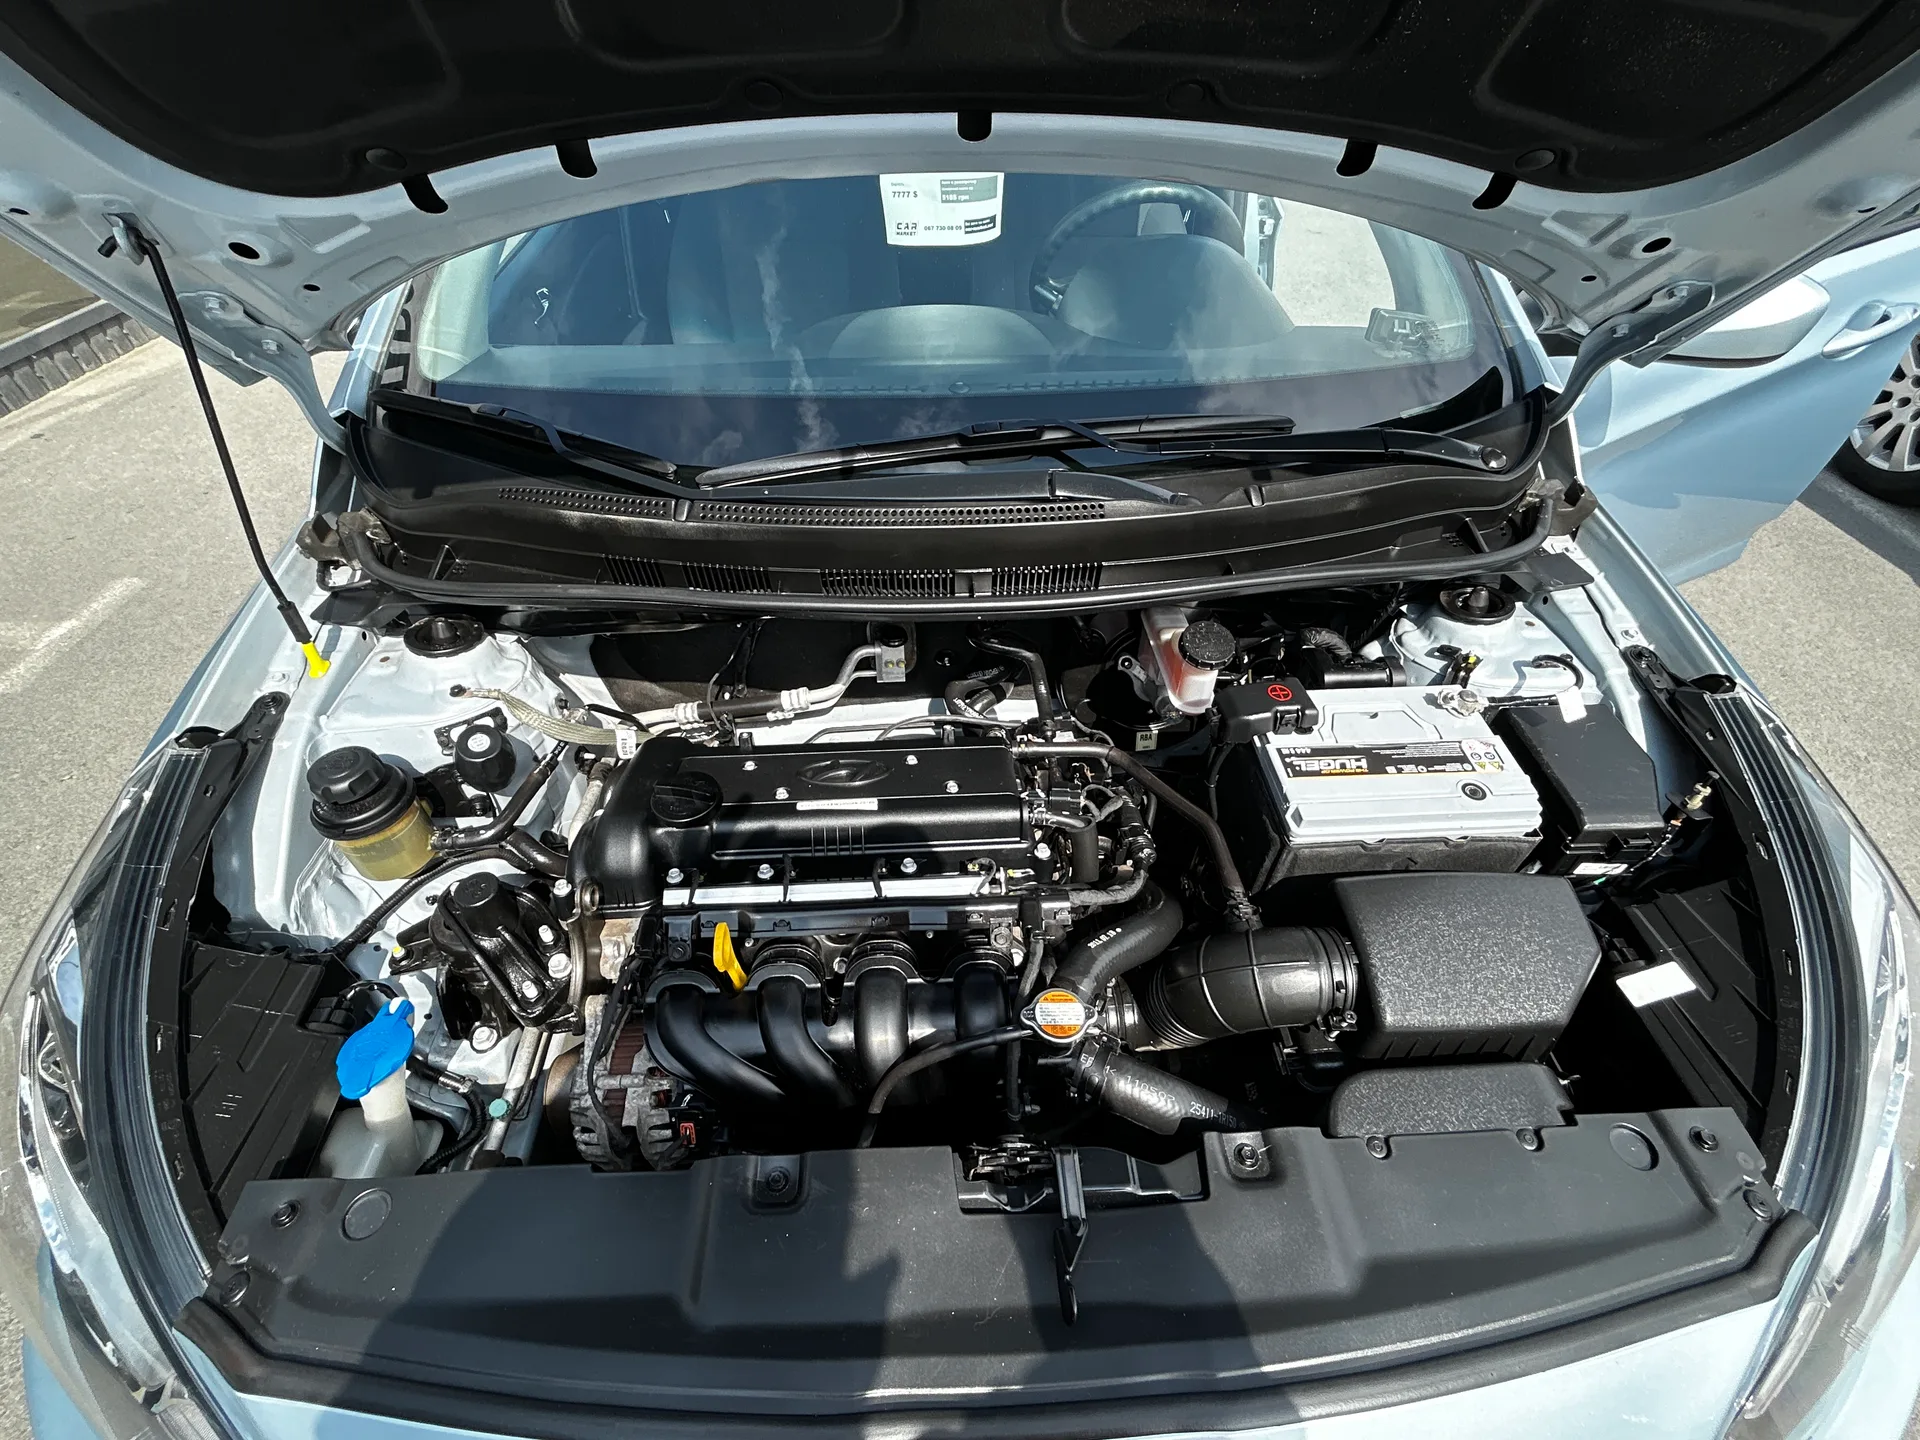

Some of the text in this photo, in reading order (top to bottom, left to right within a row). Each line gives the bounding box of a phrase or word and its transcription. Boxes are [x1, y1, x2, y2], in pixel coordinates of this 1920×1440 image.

[896, 222, 918, 230] CAR
[1139, 733, 1153, 742] RBA
[1293, 758, 1368, 772] HUGEL
